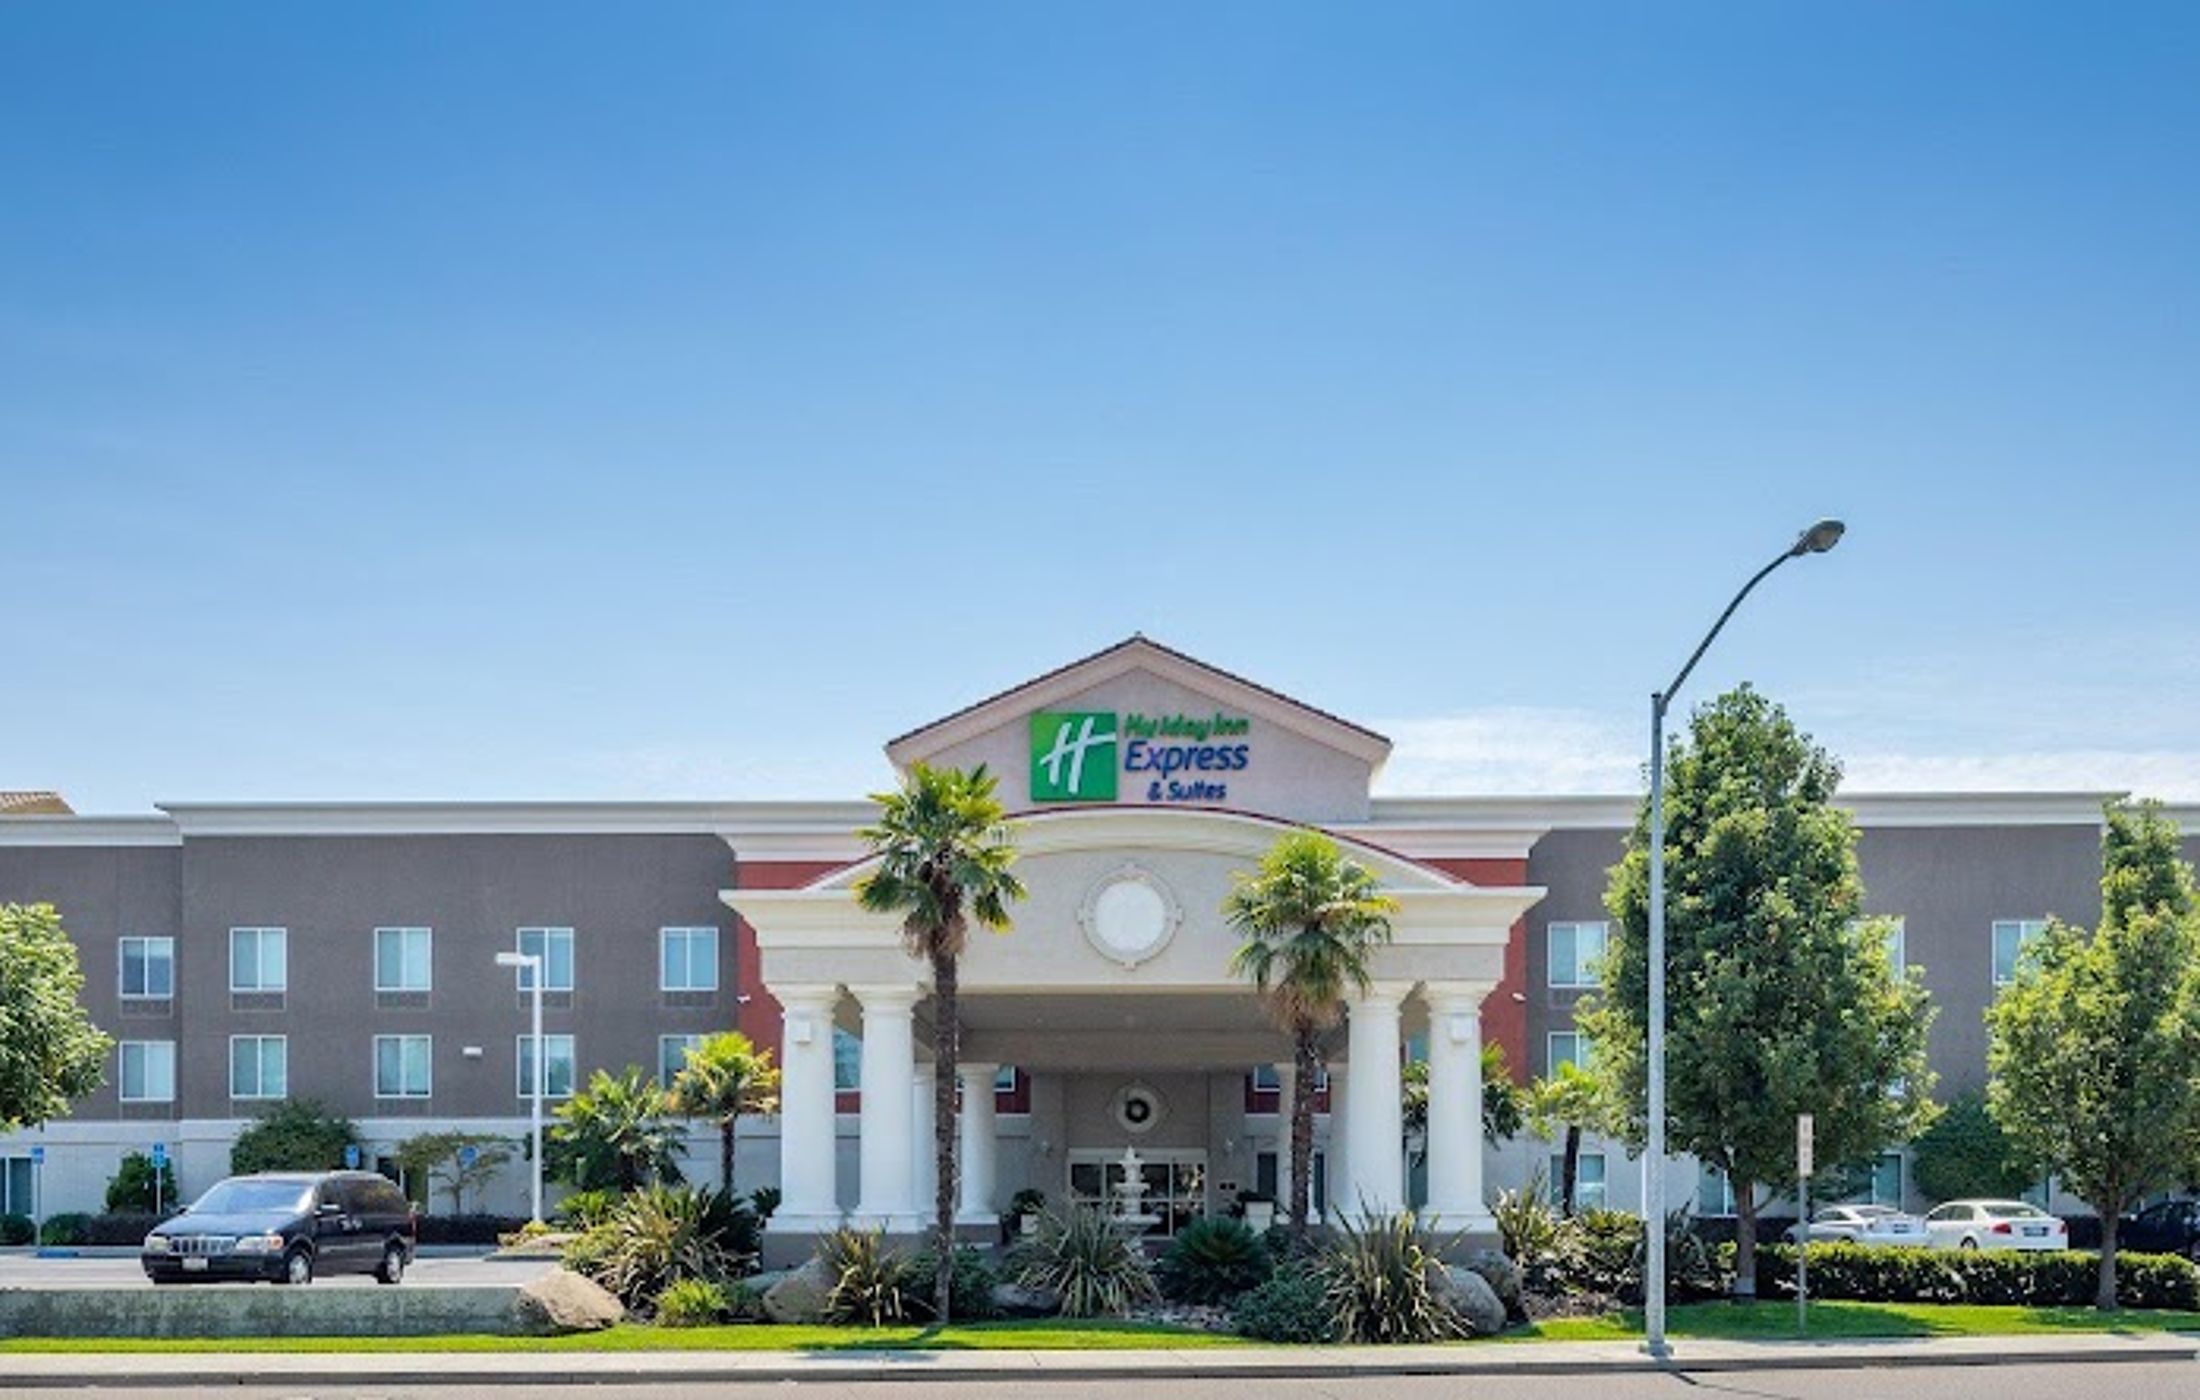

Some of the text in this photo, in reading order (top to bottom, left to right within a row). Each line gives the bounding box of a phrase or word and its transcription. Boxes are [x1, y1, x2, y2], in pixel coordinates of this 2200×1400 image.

[1124, 712, 1249, 741] Holiday Inn
[1124, 740, 1249, 779] Express
[1147, 780, 1227, 801] & Suites
